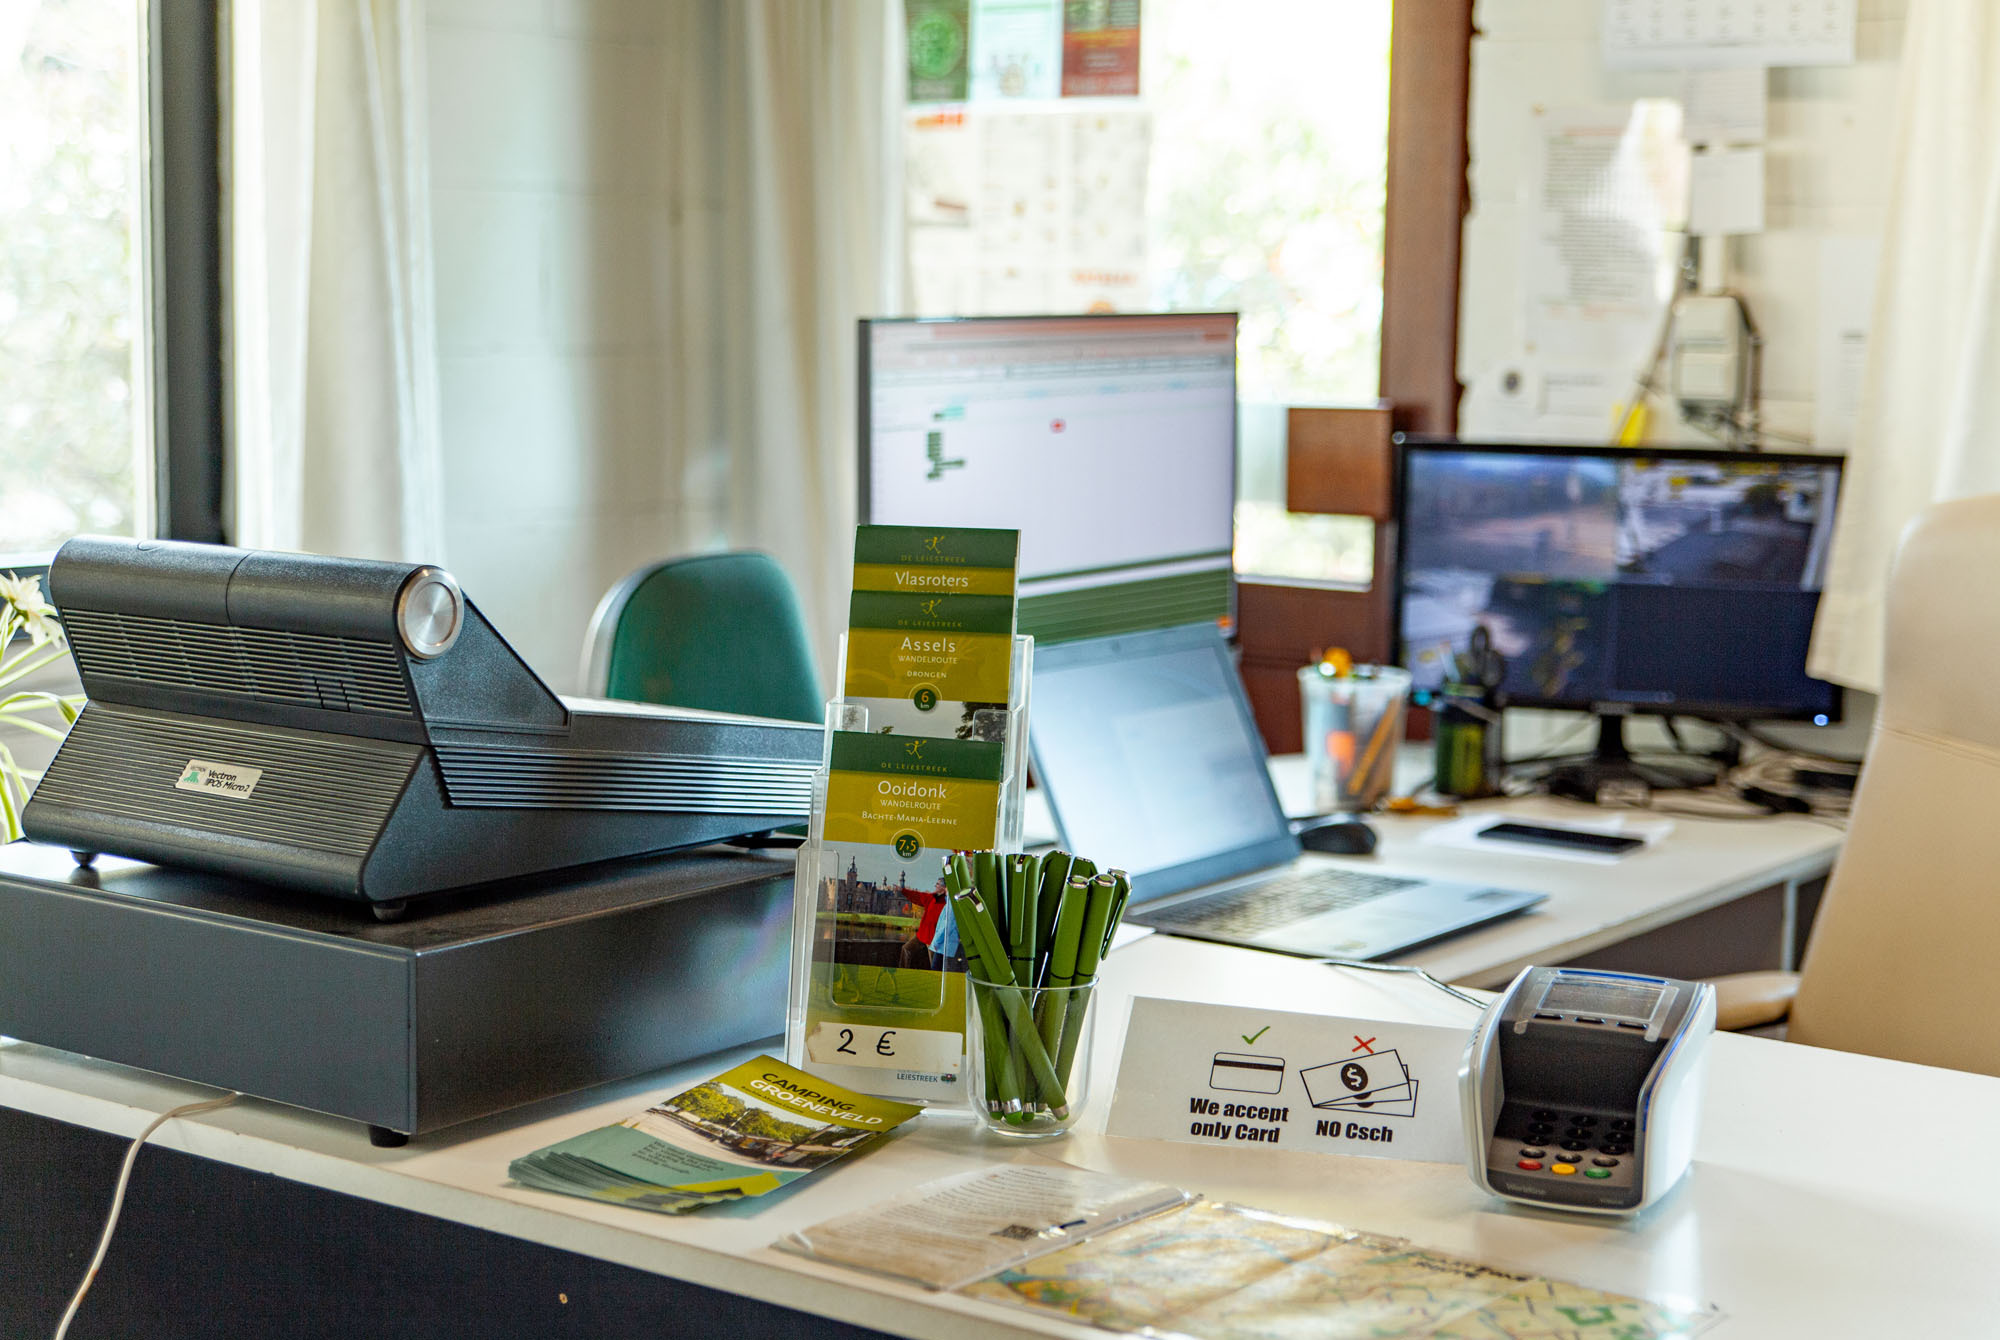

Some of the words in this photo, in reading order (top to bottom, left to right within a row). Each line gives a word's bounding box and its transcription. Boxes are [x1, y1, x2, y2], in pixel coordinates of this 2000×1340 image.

[901, 554, 913, 562] DE
[895, 570, 969, 588] Vlasroters
[900, 636, 956, 653] Assels
[898, 655, 958, 665] WANDELROUTE
[906, 670, 947, 679] DRONGEN
[921, 690, 929, 703] 6
[208, 769, 237, 782] Vectron
[896, 763, 948, 773] LEIESTREEK
[878, 780, 947, 799] Ooidonk
[880, 799, 942, 811] WANDELROUTE
[836, 1028, 857, 1055] 2
[876, 1030, 897, 1057] €
[896, 1073, 938, 1083] LEIESTREEK
[762, 1073, 856, 1111] CAMPING
[750, 1080, 883, 1125] GROENEVELD
[1190, 1097, 1220, 1116] We
[1223, 1103, 1289, 1122] accept
[1190, 1121, 1232, 1140] only
[1235, 1123, 1280, 1143] Card
[1315, 1119, 1341, 1138] NO
[1345, 1122, 1393, 1143] Csch
